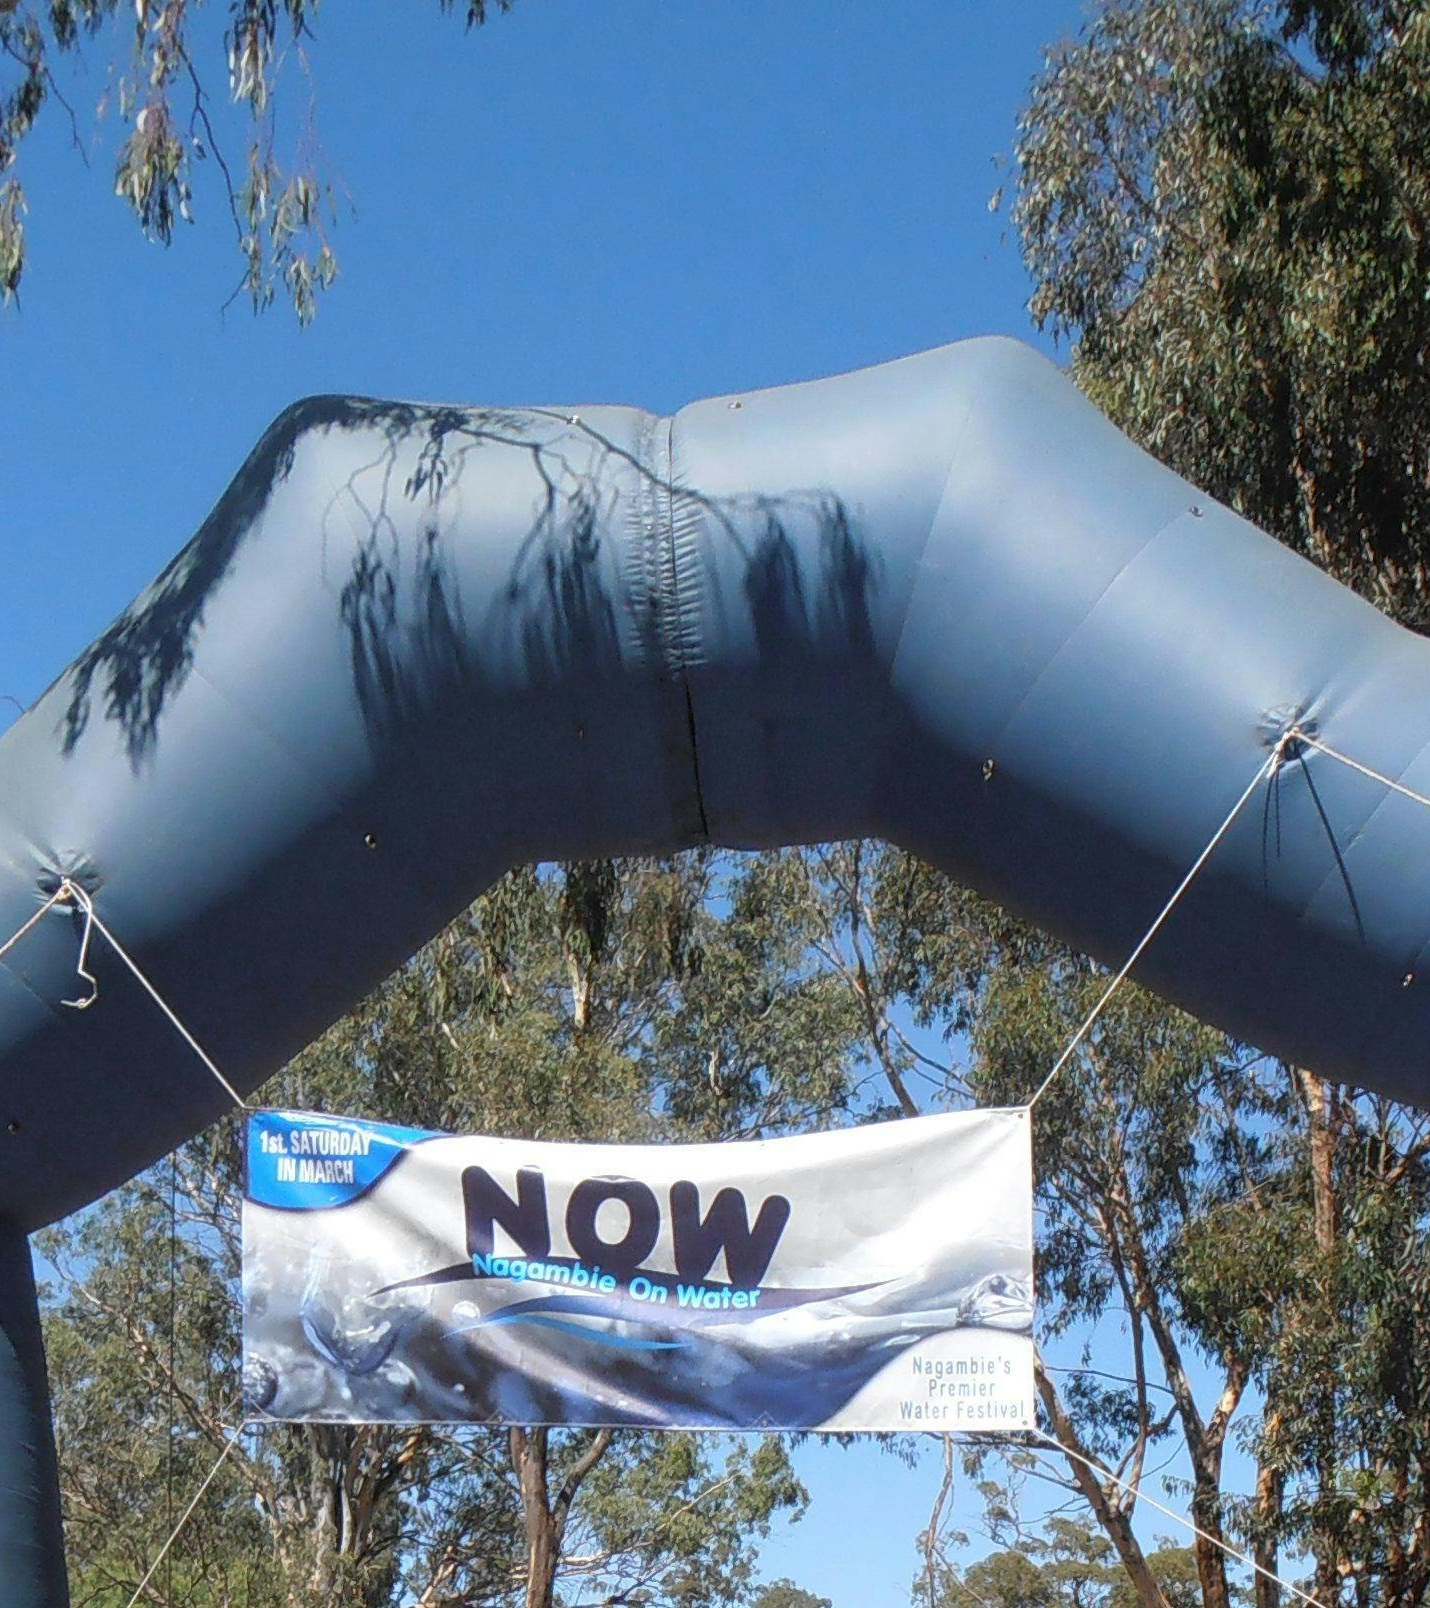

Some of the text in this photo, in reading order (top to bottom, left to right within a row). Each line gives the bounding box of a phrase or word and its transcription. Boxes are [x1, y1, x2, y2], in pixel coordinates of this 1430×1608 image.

[290, 1130, 372, 1155] SATURDAY
[277, 1158, 354, 1184] IN MARCH
[461, 1165, 791, 1287] NOW
[471, 1252, 761, 1309] Nagambie On Water
[912, 1356, 1011, 1379] Nagambie's
[928, 1379, 995, 1397] Premier
[900, 1400, 1024, 1419] Water Festival
